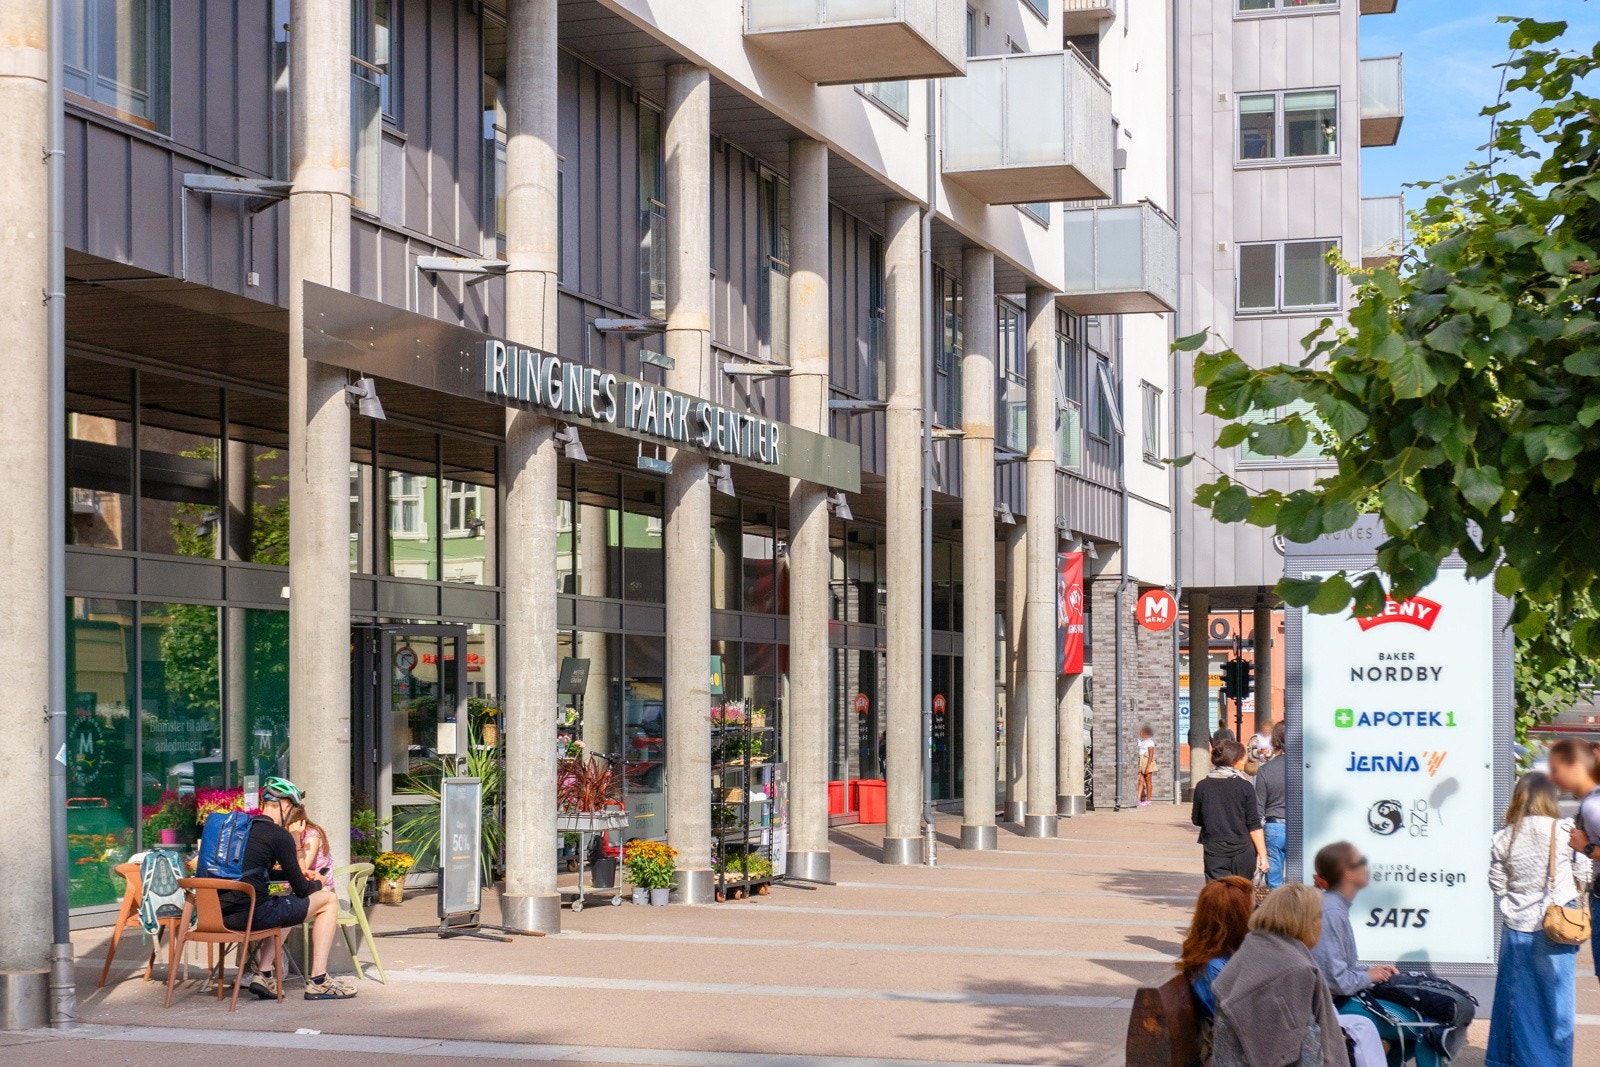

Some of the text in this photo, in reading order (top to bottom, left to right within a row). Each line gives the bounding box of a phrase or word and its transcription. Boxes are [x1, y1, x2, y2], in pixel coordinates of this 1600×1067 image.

[486, 340, 780, 465] RINGNES PARK SENTER
[1144, 597, 1169, 618] M
[1366, 600, 1433, 622] ENY
[1379, 652, 1415, 661] BAKER
[1350, 666, 1442, 681] NORDBY
[1357, 711, 1457, 727] APOTEK 1
[453, 834, 470, 852] 50%
[1372, 868, 1466, 887] erndesign
[1366, 908, 1431, 928] SATS
